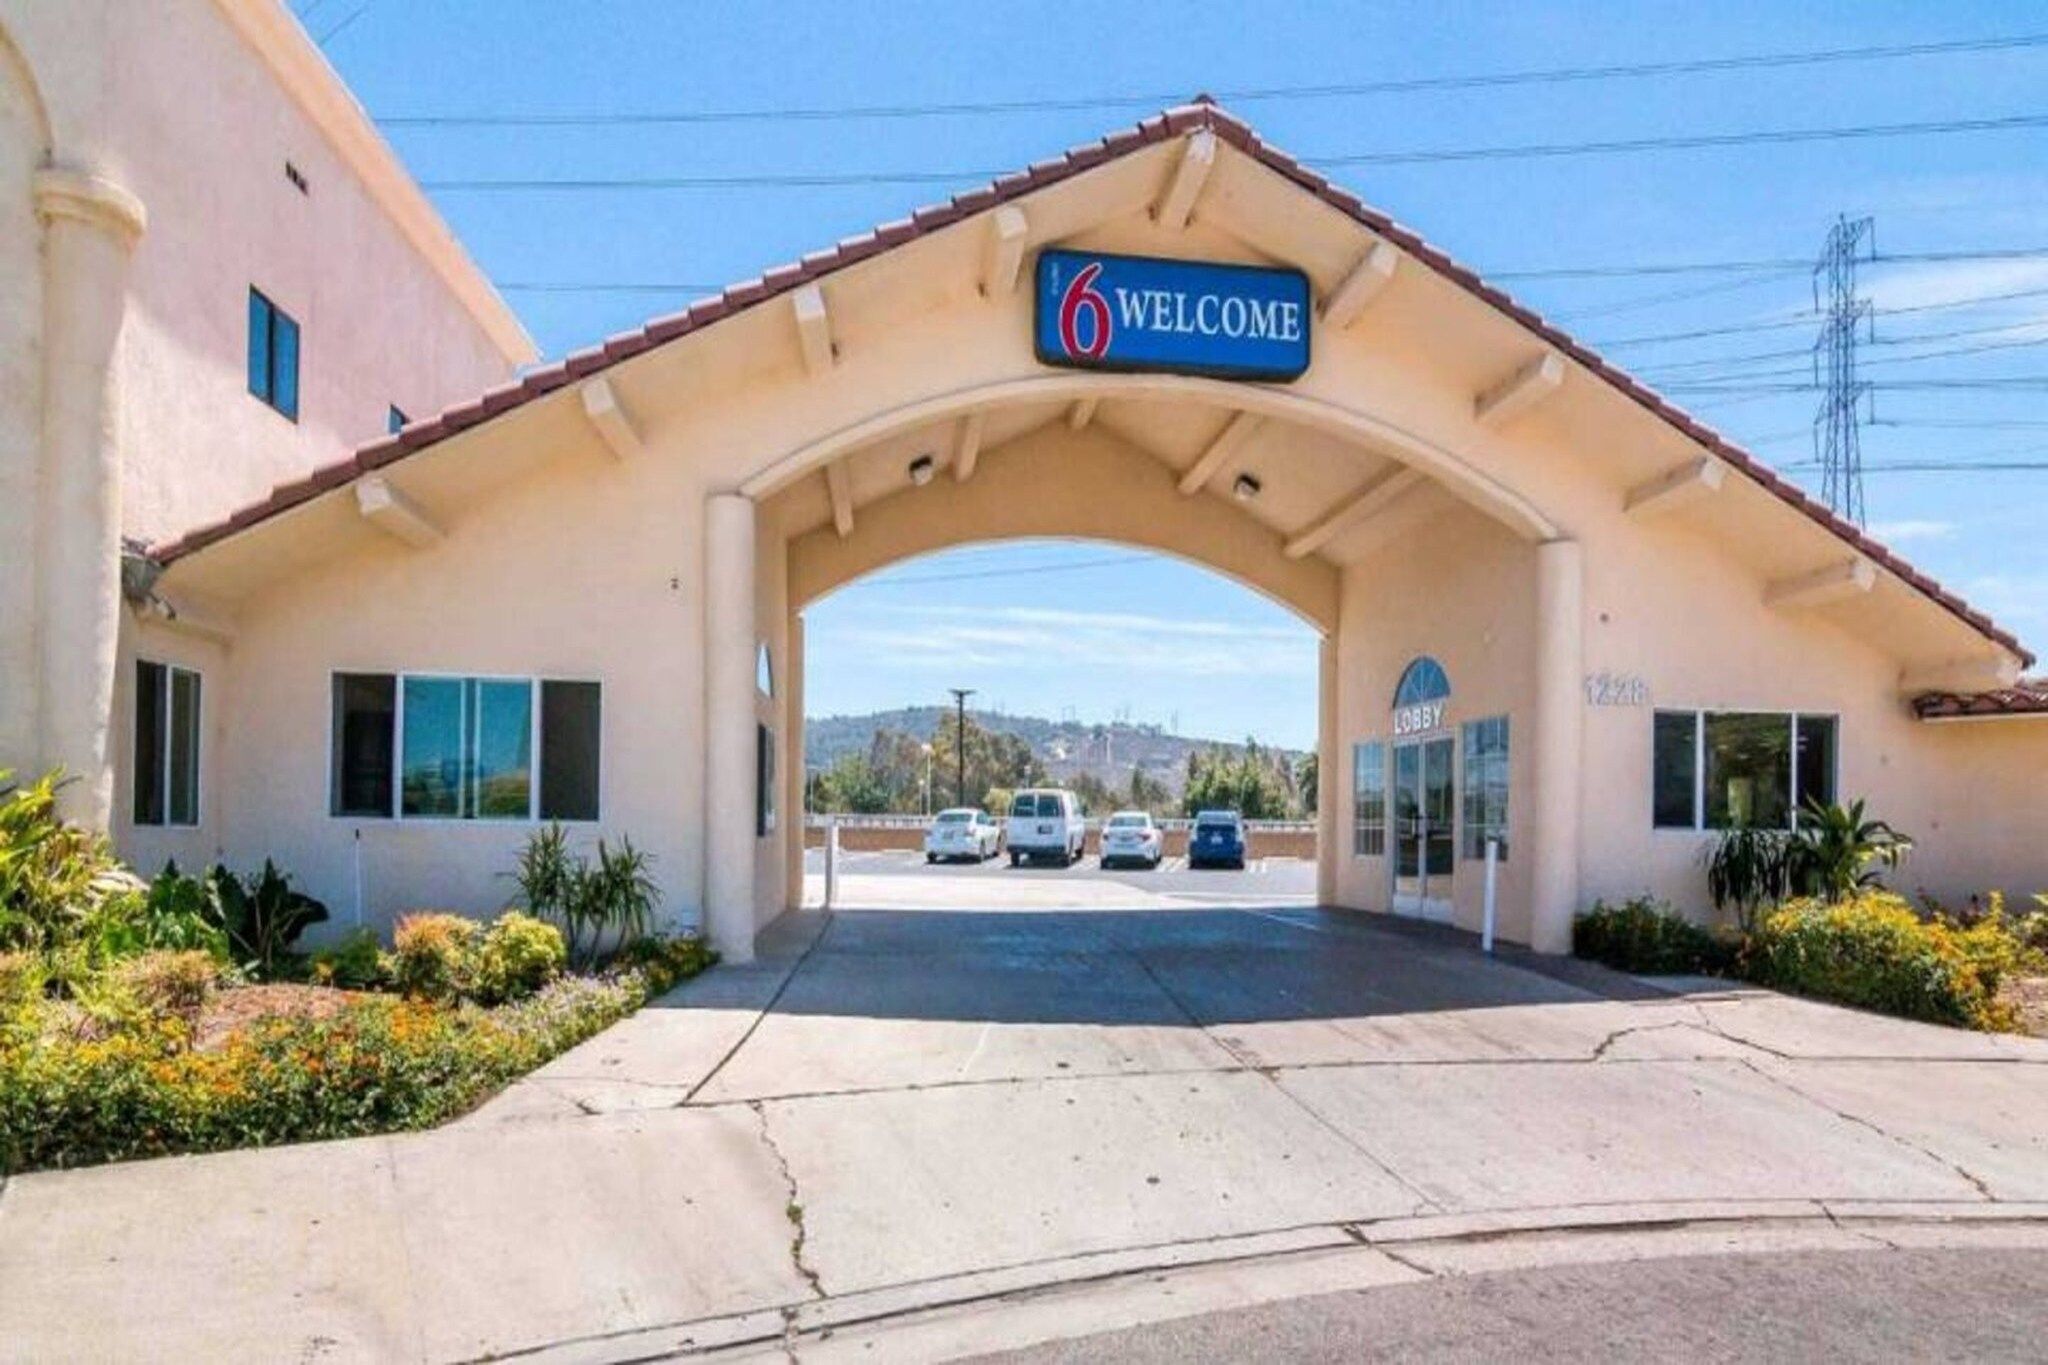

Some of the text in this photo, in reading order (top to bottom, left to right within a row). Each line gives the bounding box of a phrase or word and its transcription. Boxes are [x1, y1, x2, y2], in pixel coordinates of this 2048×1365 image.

[1059, 262, 1112, 362] 6
[1116, 287, 1299, 342] WELCOME
[1394, 704, 1443, 735] LOBBY
